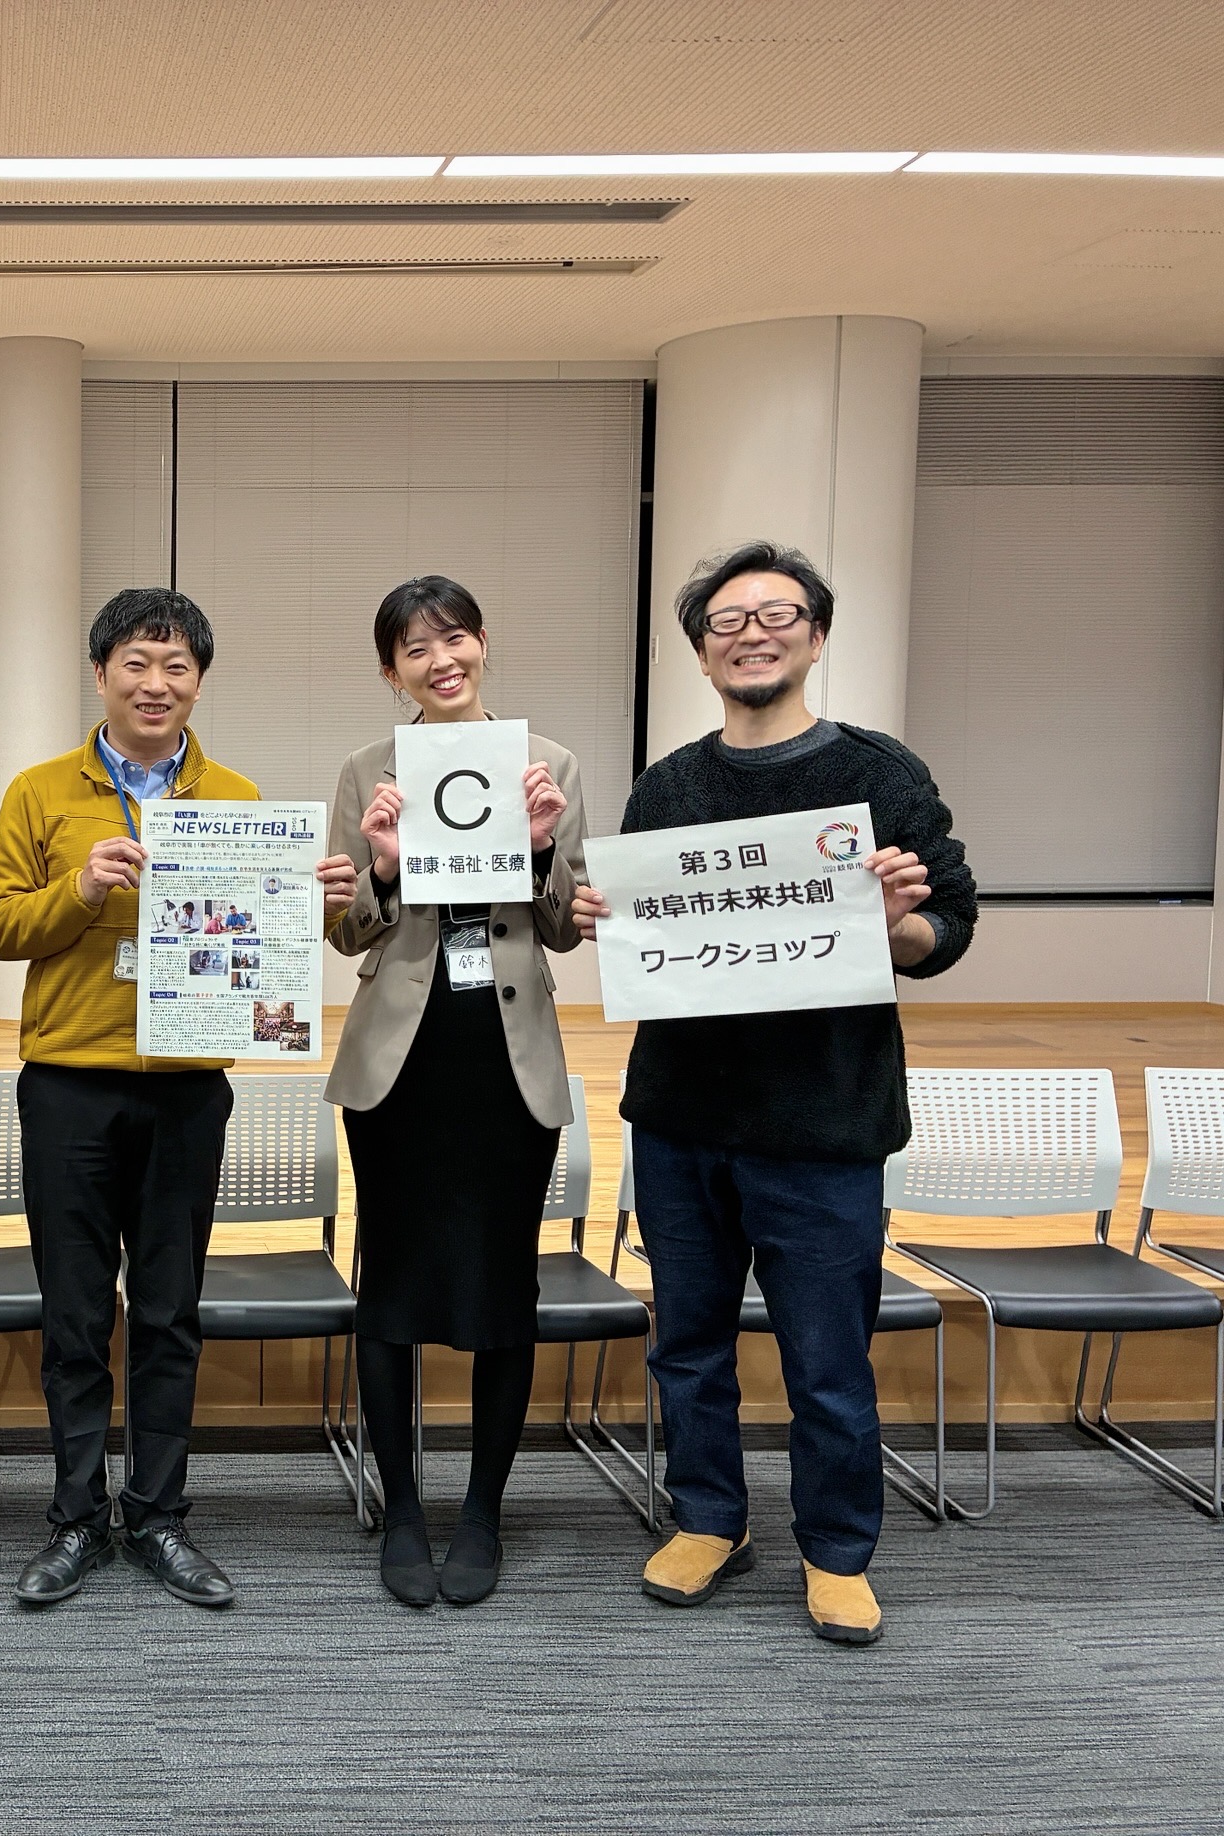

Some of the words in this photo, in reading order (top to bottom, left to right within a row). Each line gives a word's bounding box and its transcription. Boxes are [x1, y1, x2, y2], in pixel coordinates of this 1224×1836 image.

[434, 769, 492, 830] C
[173, 822, 284, 836] NEWSLETTER
[299, 817, 307, 831] 1
[406, 853, 526, 874] 健康・福祉・医療
[678, 843, 768, 876] 第3回
[837, 861, 863, 871] 岐阜市
[633, 877, 834, 920] 岐阜市未来共創
[459, 955, 489, 969] 鈴木
[640, 930, 841, 973] ワークショップ
